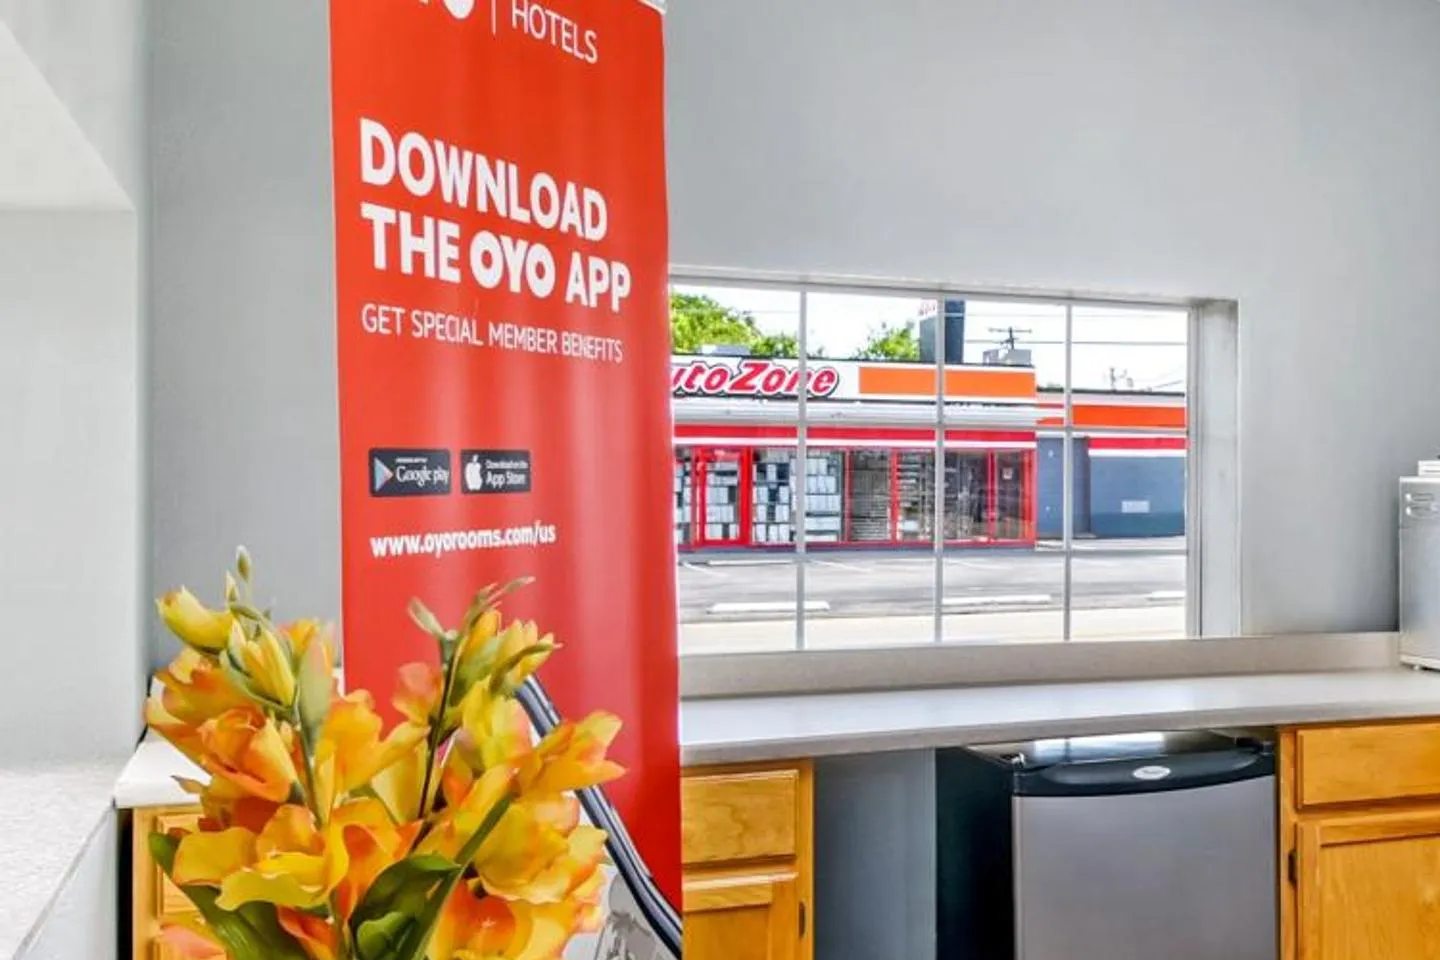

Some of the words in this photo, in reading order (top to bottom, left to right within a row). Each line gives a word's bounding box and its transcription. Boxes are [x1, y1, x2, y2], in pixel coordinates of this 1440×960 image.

[511, 0, 598, 64] HOTELS
[360, 117, 608, 242] DOWNLOAD
[360, 202, 461, 284] THE
[469, 230, 556, 299] OYO
[565, 251, 632, 314] APP
[361, 303, 405, 336] GET
[411, 309, 484, 346] SPECIAL
[488, 322, 558, 355] MEMBER
[561, 331, 624, 364] BENEFITS
[671, 362, 837, 396] utoZone
[395, 465, 432, 487] Google
[485, 471, 505, 489] App
[506, 471, 526, 485] Store
[369, 520, 557, 558] www.oyorooms.com/us
